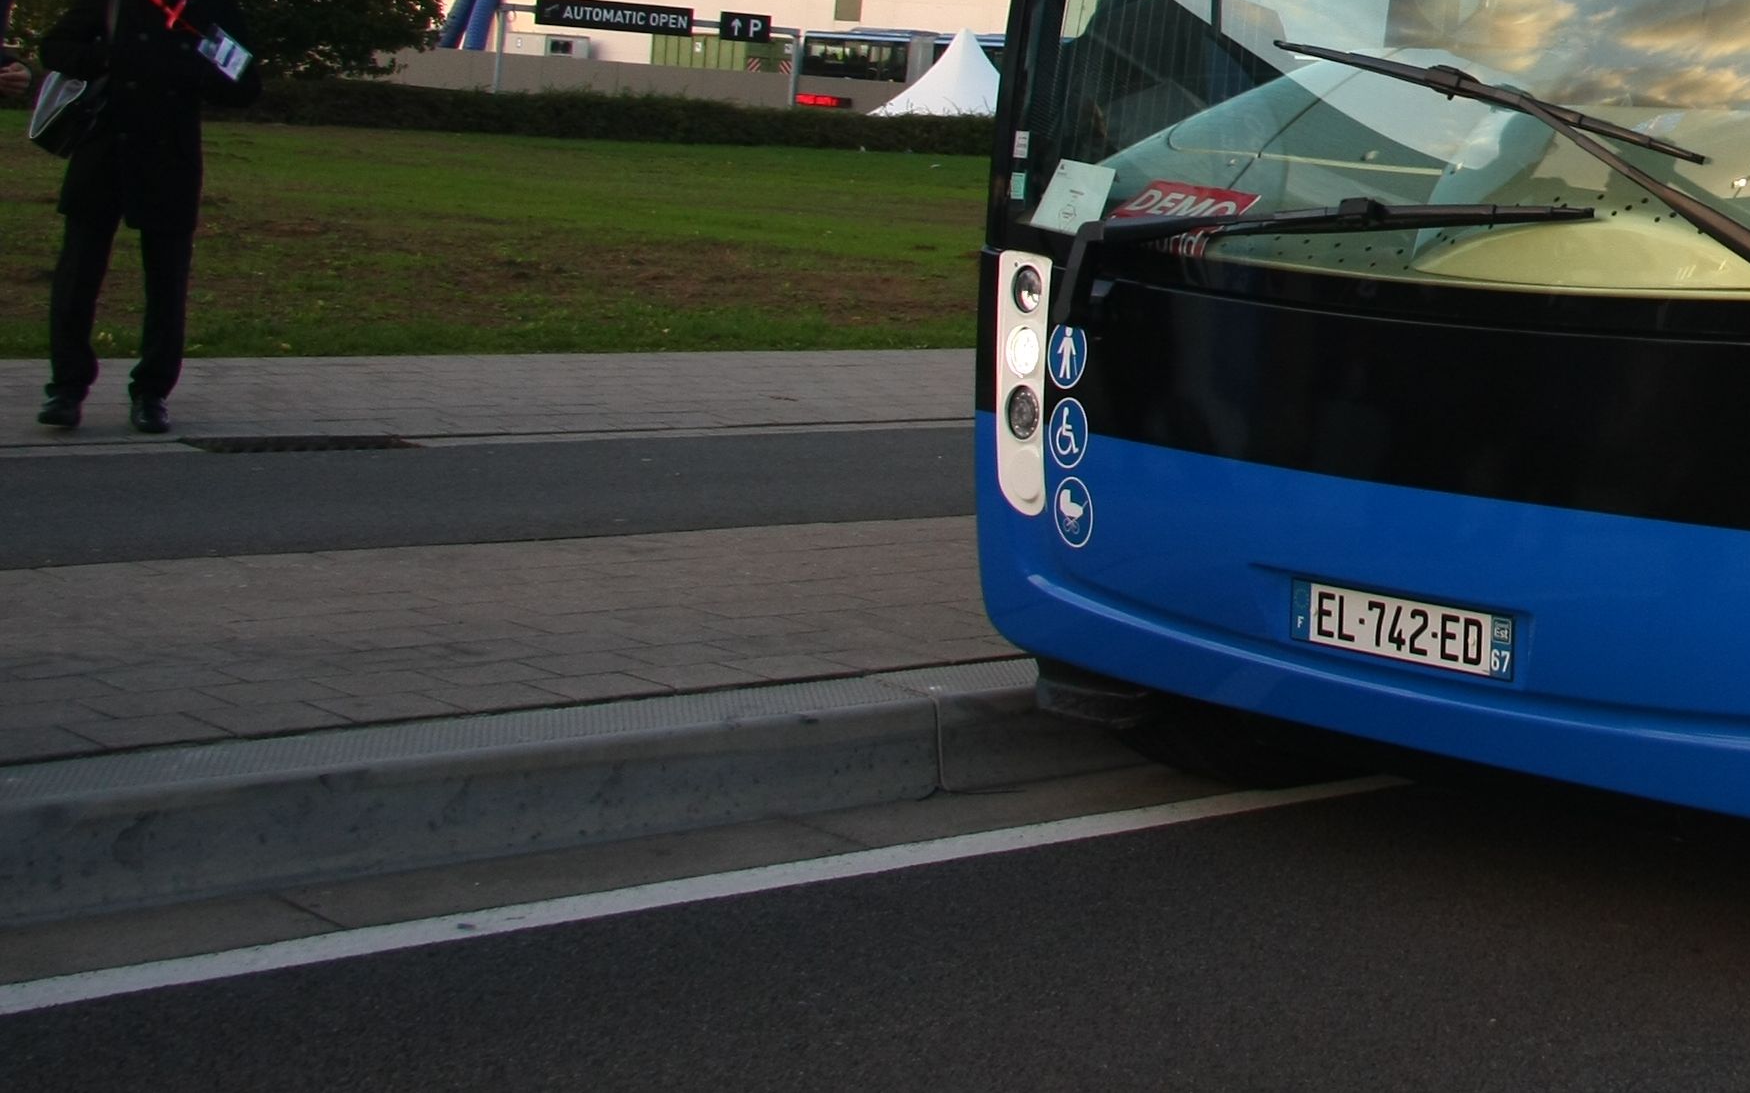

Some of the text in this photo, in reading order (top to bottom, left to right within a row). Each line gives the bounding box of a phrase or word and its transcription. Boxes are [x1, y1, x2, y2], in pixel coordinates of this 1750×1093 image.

[562, 6, 688, 29] AUTOMATIC OPEN
[750, 19, 762, 37] P
[1297, 616, 1304, 629] F
[1318, 591, 1483, 666] EL-742-ED
[1491, 649, 1511, 673] 67
